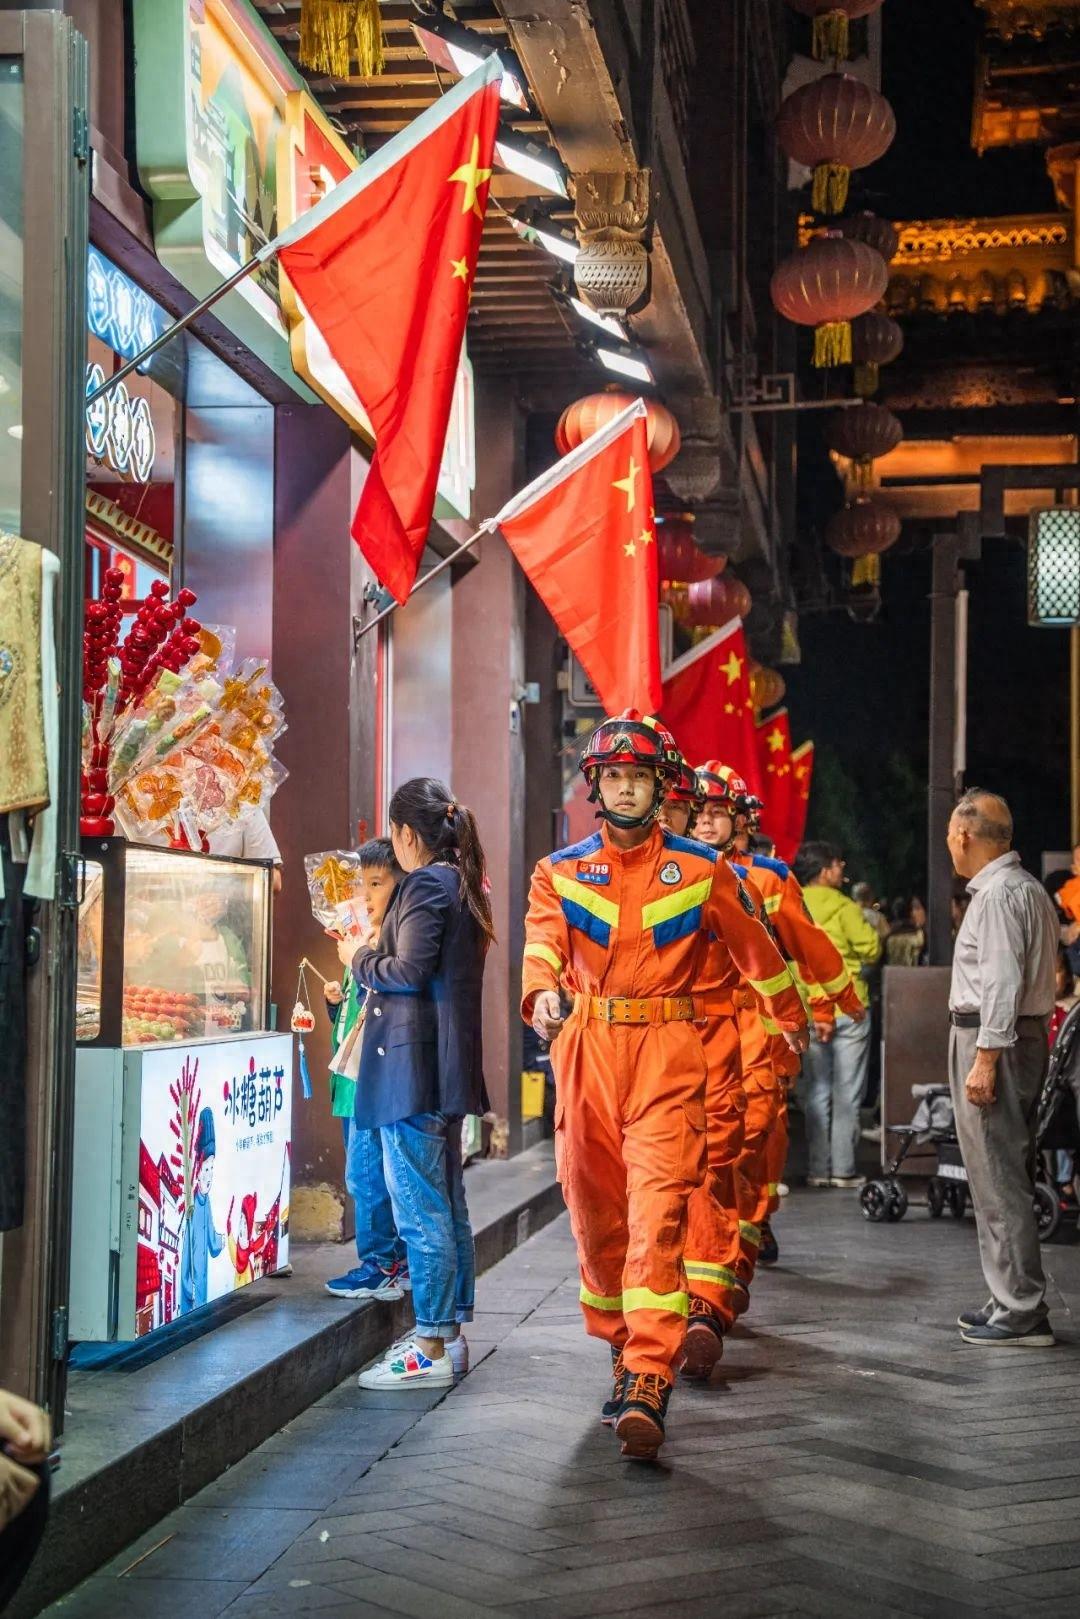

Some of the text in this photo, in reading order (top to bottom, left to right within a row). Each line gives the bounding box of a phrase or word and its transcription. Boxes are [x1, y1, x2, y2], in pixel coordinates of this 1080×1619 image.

[589, 863, 609, 875] 119
[223, 1056, 284, 1128] 冰糖葫芦
